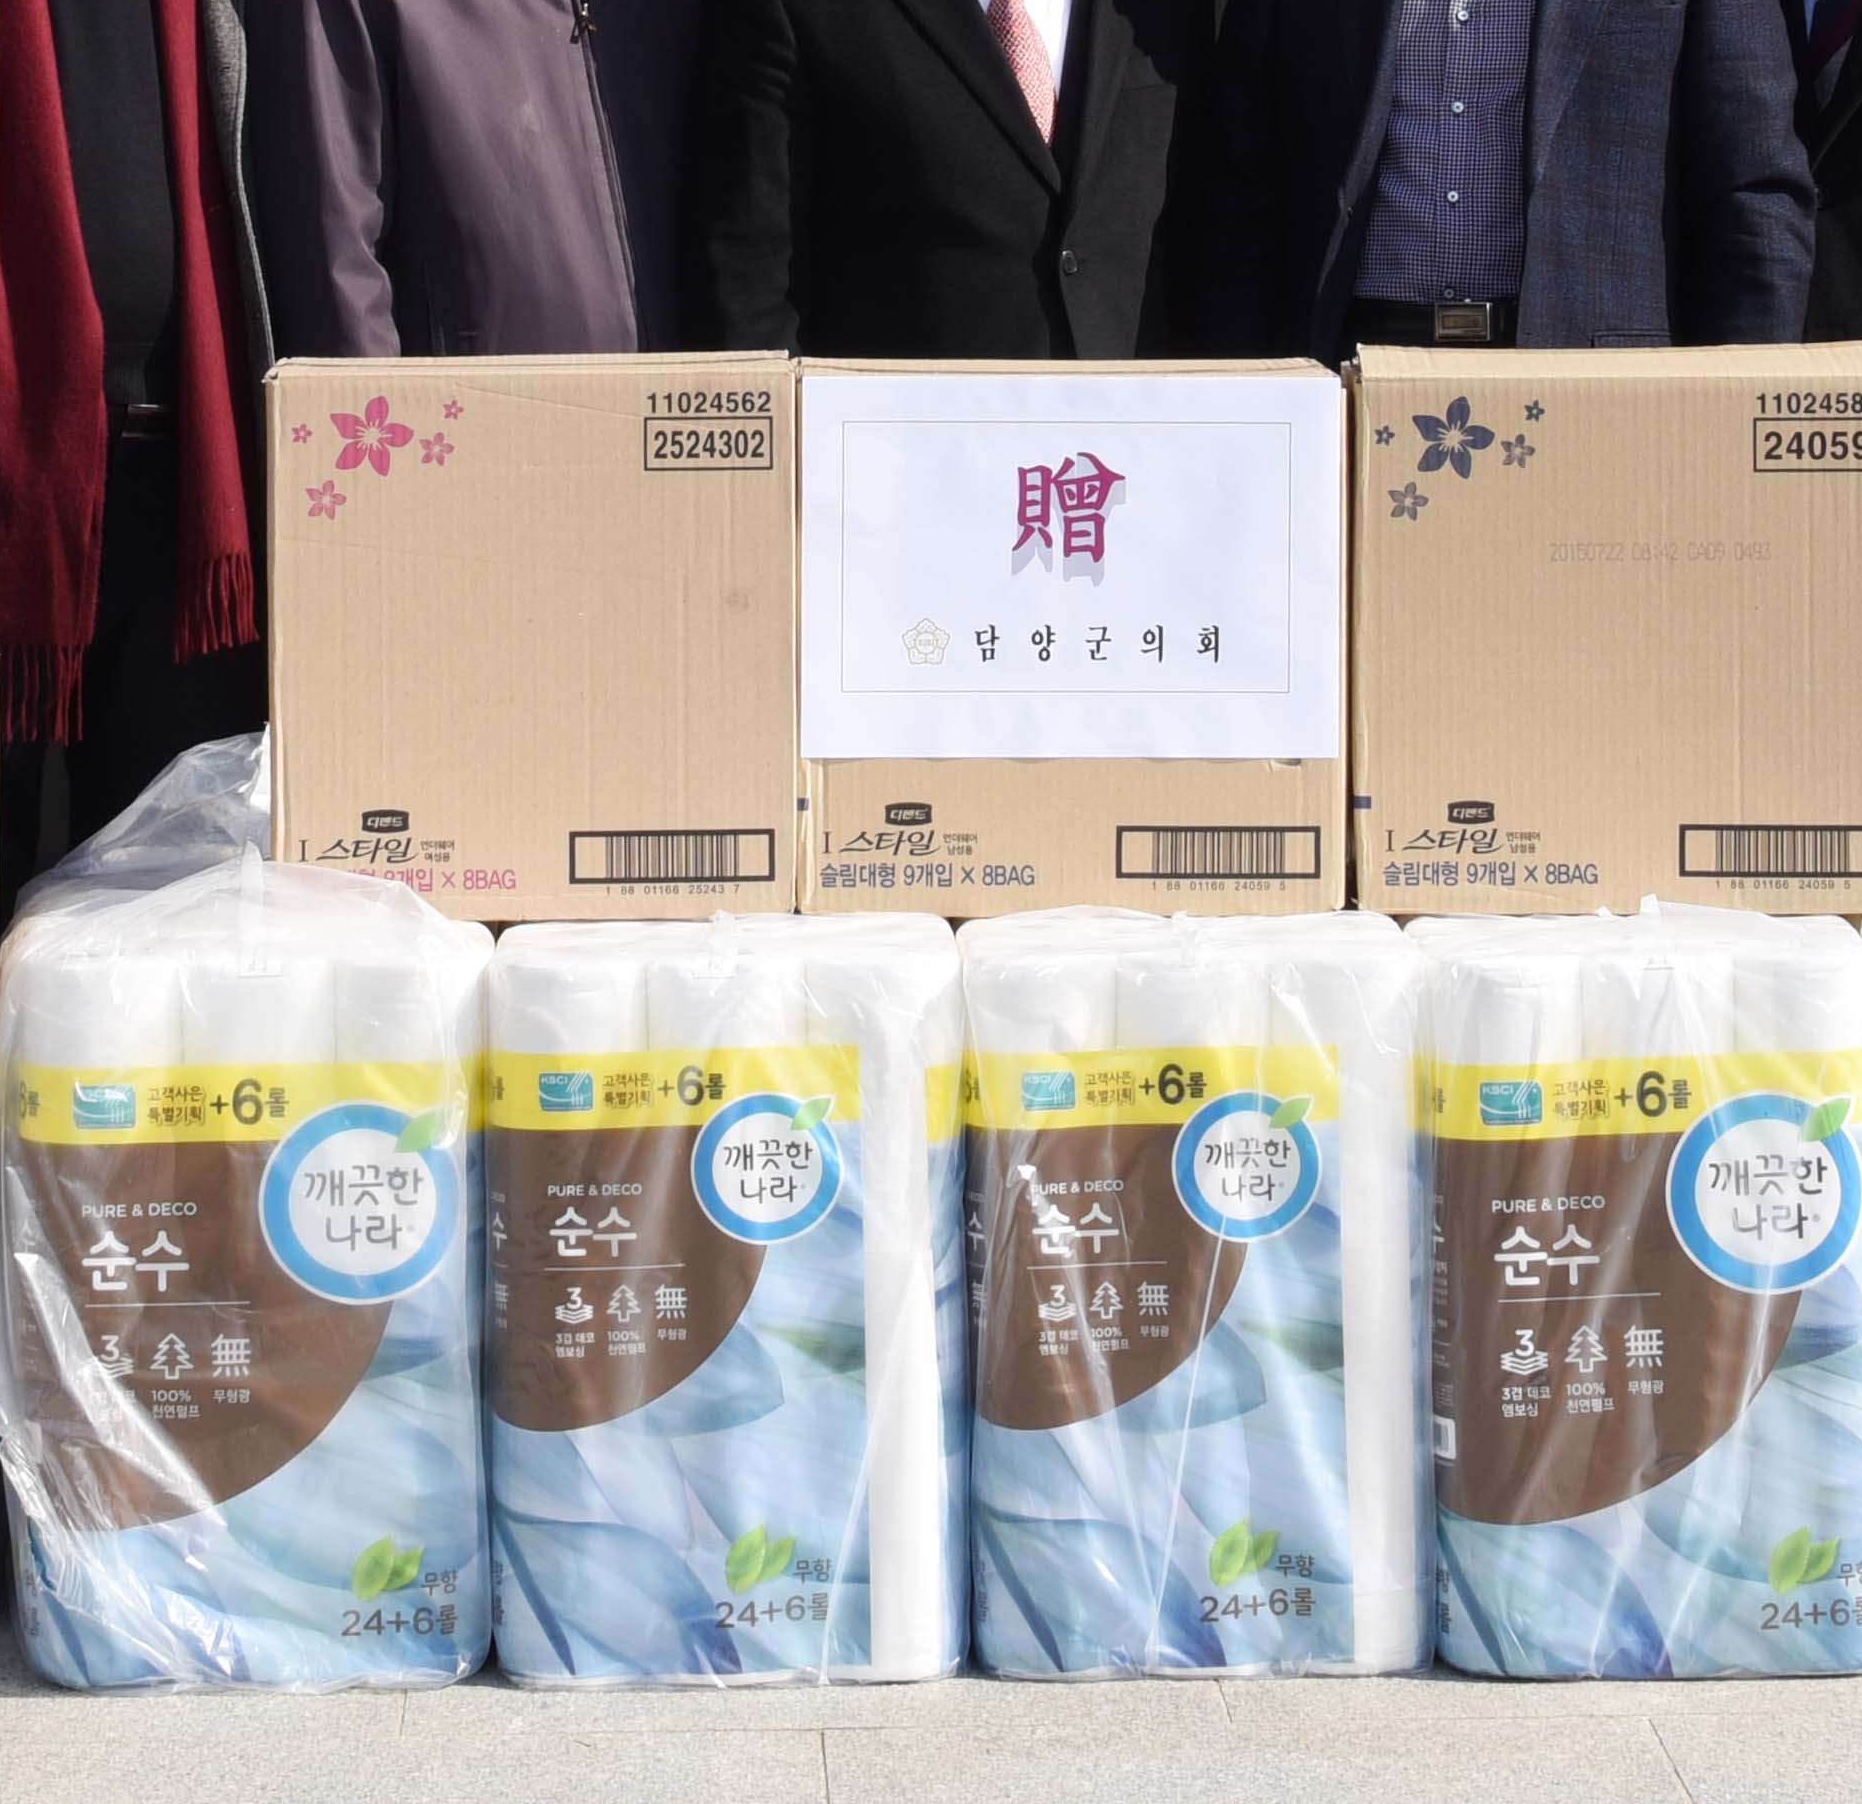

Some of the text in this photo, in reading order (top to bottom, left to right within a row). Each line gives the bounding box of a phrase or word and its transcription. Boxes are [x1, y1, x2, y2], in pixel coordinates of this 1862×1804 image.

[646, 392, 771, 414] 11024562
[654, 431, 764, 459] 2524302
[1012, 452, 1126, 563] 贈
[316, 838, 419, 864] 스타일
[839, 830, 940, 856] 스타일
[1402, 828, 1504, 854] 스타일
[463, 869, 516, 890] 8BAG
[820, 863, 895, 888] 슬림대형
[904, 863, 953, 888] 9개입
[982, 865, 1035, 886] 8BAG
[1383, 861, 1459, 886] 슬림대형
[1467, 861, 1515, 886] 9개입
[1546, 863, 1598, 884] 8BAG
[724, 1141, 812, 1172] 깨끗한
[1205, 1138, 1289, 1171] 깨끗한
[304, 1165, 423, 1208] 깨끗한
[548, 1183, 642, 1196] PURE & DECO
[740, 1176, 795, 1205] 나라
[1031, 1180, 1123, 1196] PURE & DECO
[1222, 1173, 1274, 1202] 나라
[1710, 1155, 1827, 1198] 깨끗한
[82, 1202, 197, 1218] PURE & DECO
[1492, 1195, 1605, 1213] PURE & DECO
[326, 1213, 403, 1251] 나라
[549, 1206, 637, 1258] 순수
[1031, 1203, 1119, 1256] 순수
[1733, 1203, 1807, 1241] 나라
[82, 1230, 189, 1293] 순수
[1494, 1223, 1600, 1287] 순수
[655, 1284, 687, 1319] 無
[1138, 1281, 1169, 1316] 無
[607, 1331, 639, 1341] 100%
[1091, 1327, 1122, 1337] 100%
[1624, 1325, 1664, 1368] 無
[211, 1334, 251, 1377] 無
[151, 1390, 191, 1402] 100%
[1566, 1382, 1605, 1396] 100%
[794, 1559, 831, 1583] 무향
[1276, 1554, 1314, 1579] 무향
[420, 1572, 458, 1596] 무향
[715, 1594, 829, 1629] 24+6롤
[1199, 1588, 1315, 1624] 24+6롤
[342, 1605, 457, 1638] 24+6롤
